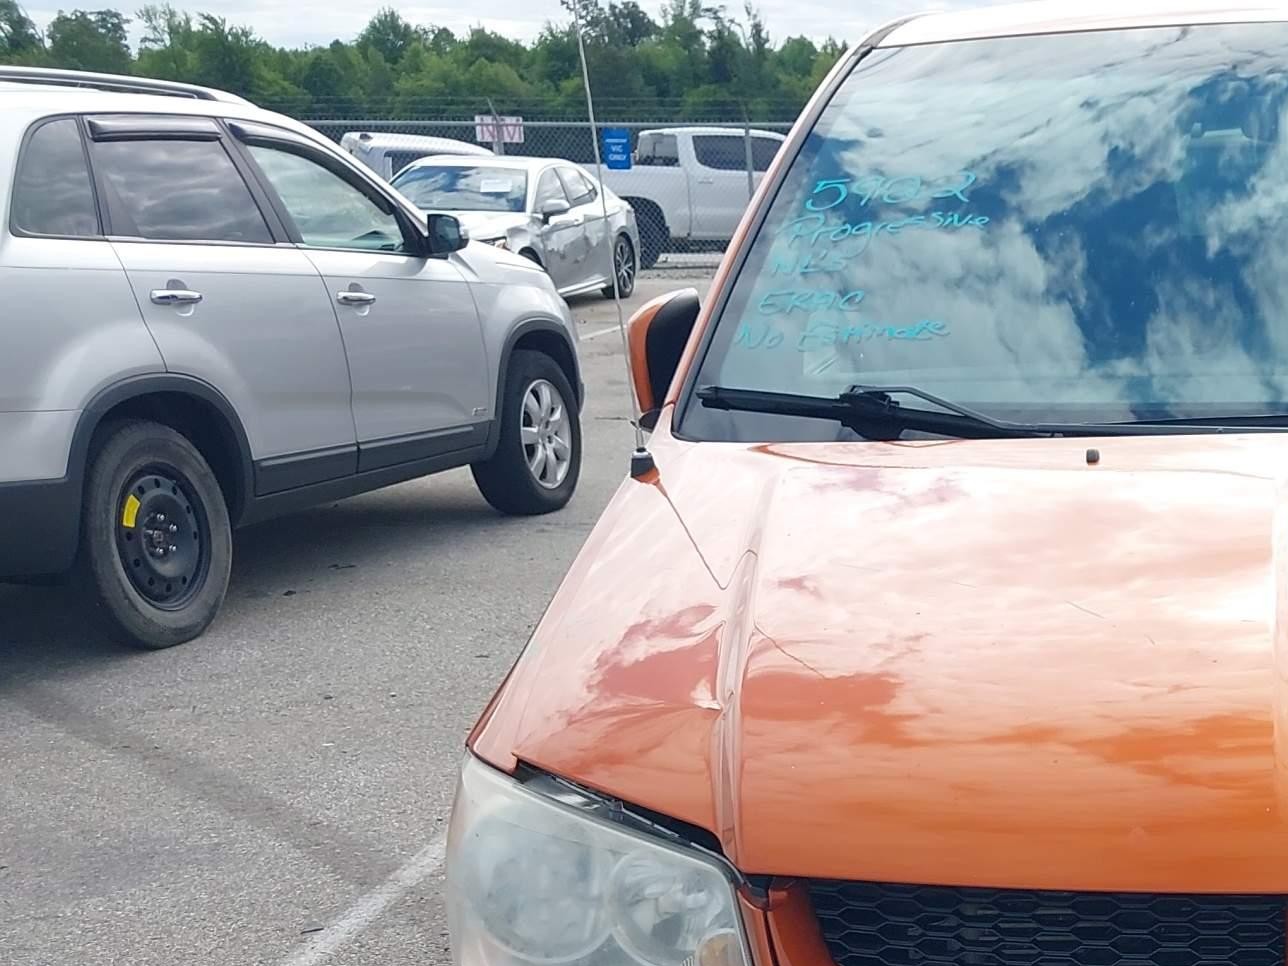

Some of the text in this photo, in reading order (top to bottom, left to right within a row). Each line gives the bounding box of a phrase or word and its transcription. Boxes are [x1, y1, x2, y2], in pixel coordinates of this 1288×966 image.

[806, 172, 976, 210] 5902
[782, 211, 990, 258] Progressive
[736, 324, 784, 349] No
